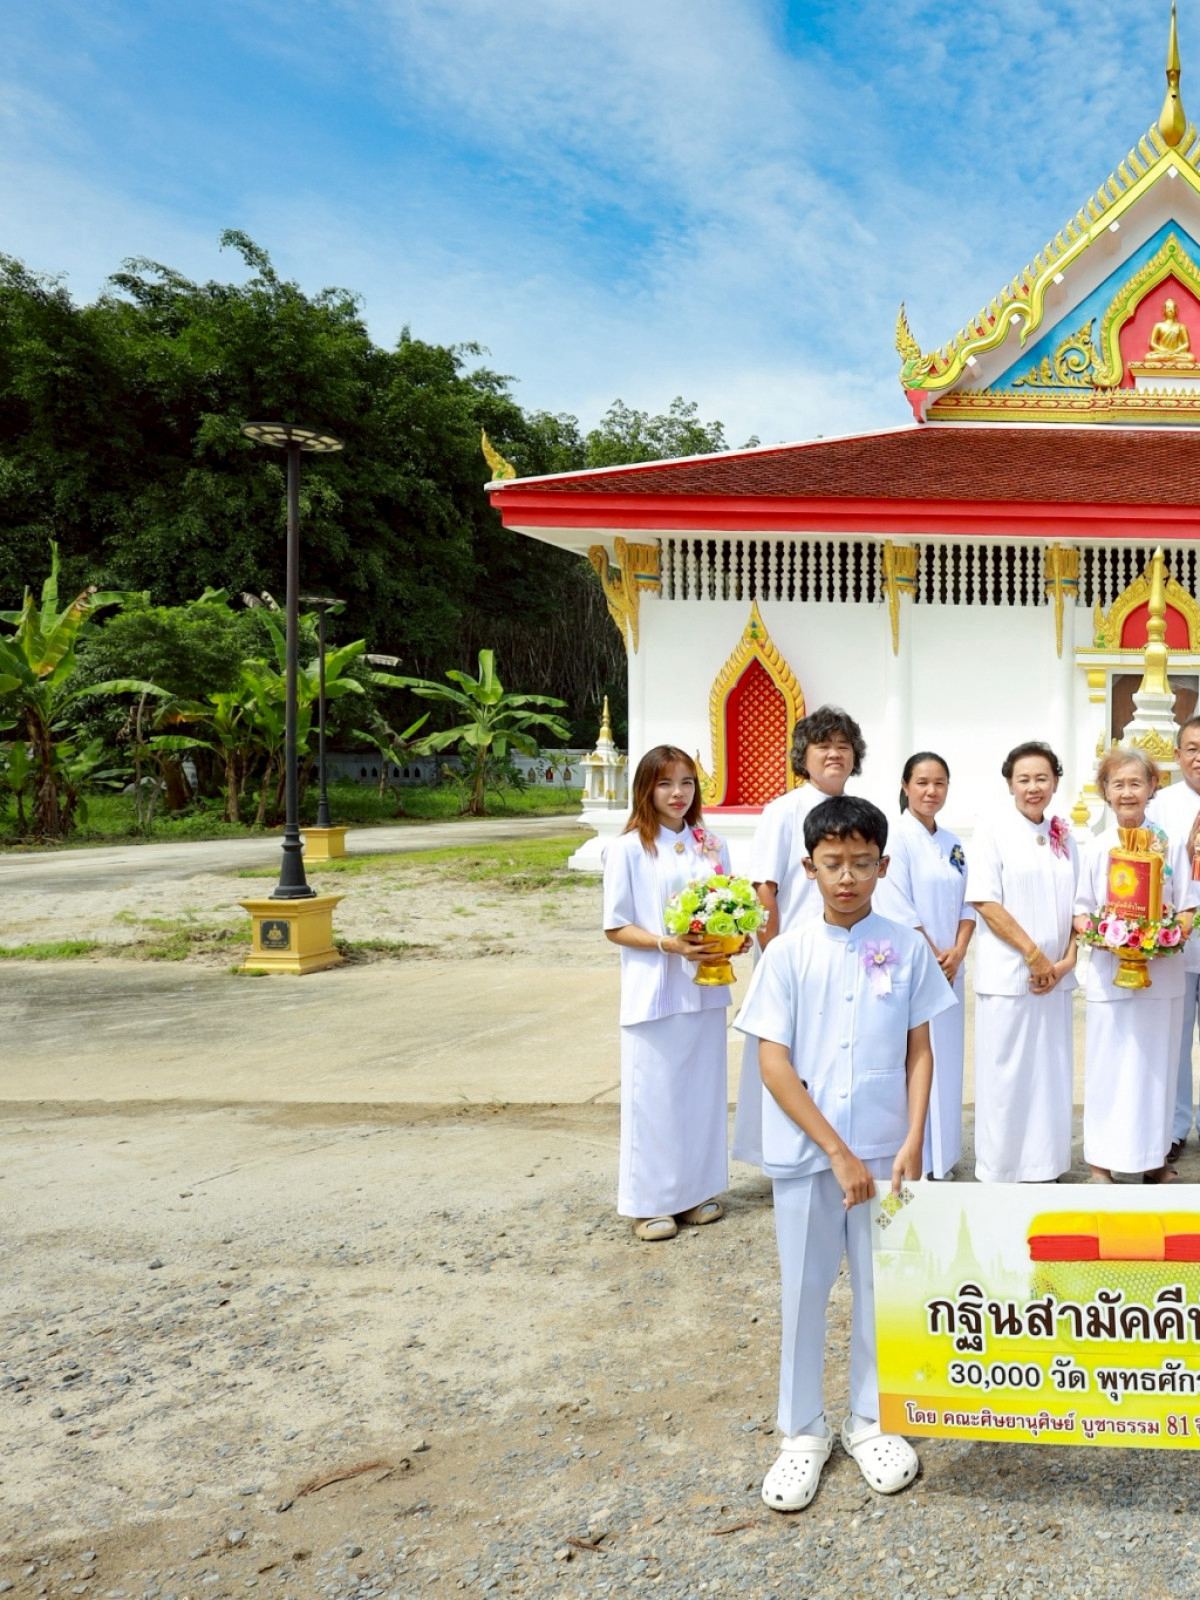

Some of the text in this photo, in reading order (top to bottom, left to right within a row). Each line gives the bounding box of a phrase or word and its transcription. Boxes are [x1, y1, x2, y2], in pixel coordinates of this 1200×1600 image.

[951, 1364, 1040, 1390] 30,000
[1051, 1360, 1086, 1390] วัด
[906, 1403, 936, 1424] โดย
[944, 1410, 1075, 1435] คณะศิษยานุศิษย์
[1082, 1418, 1160, 1438] บูชาธรรม
[1166, 1415, 1190, 1436] 81
